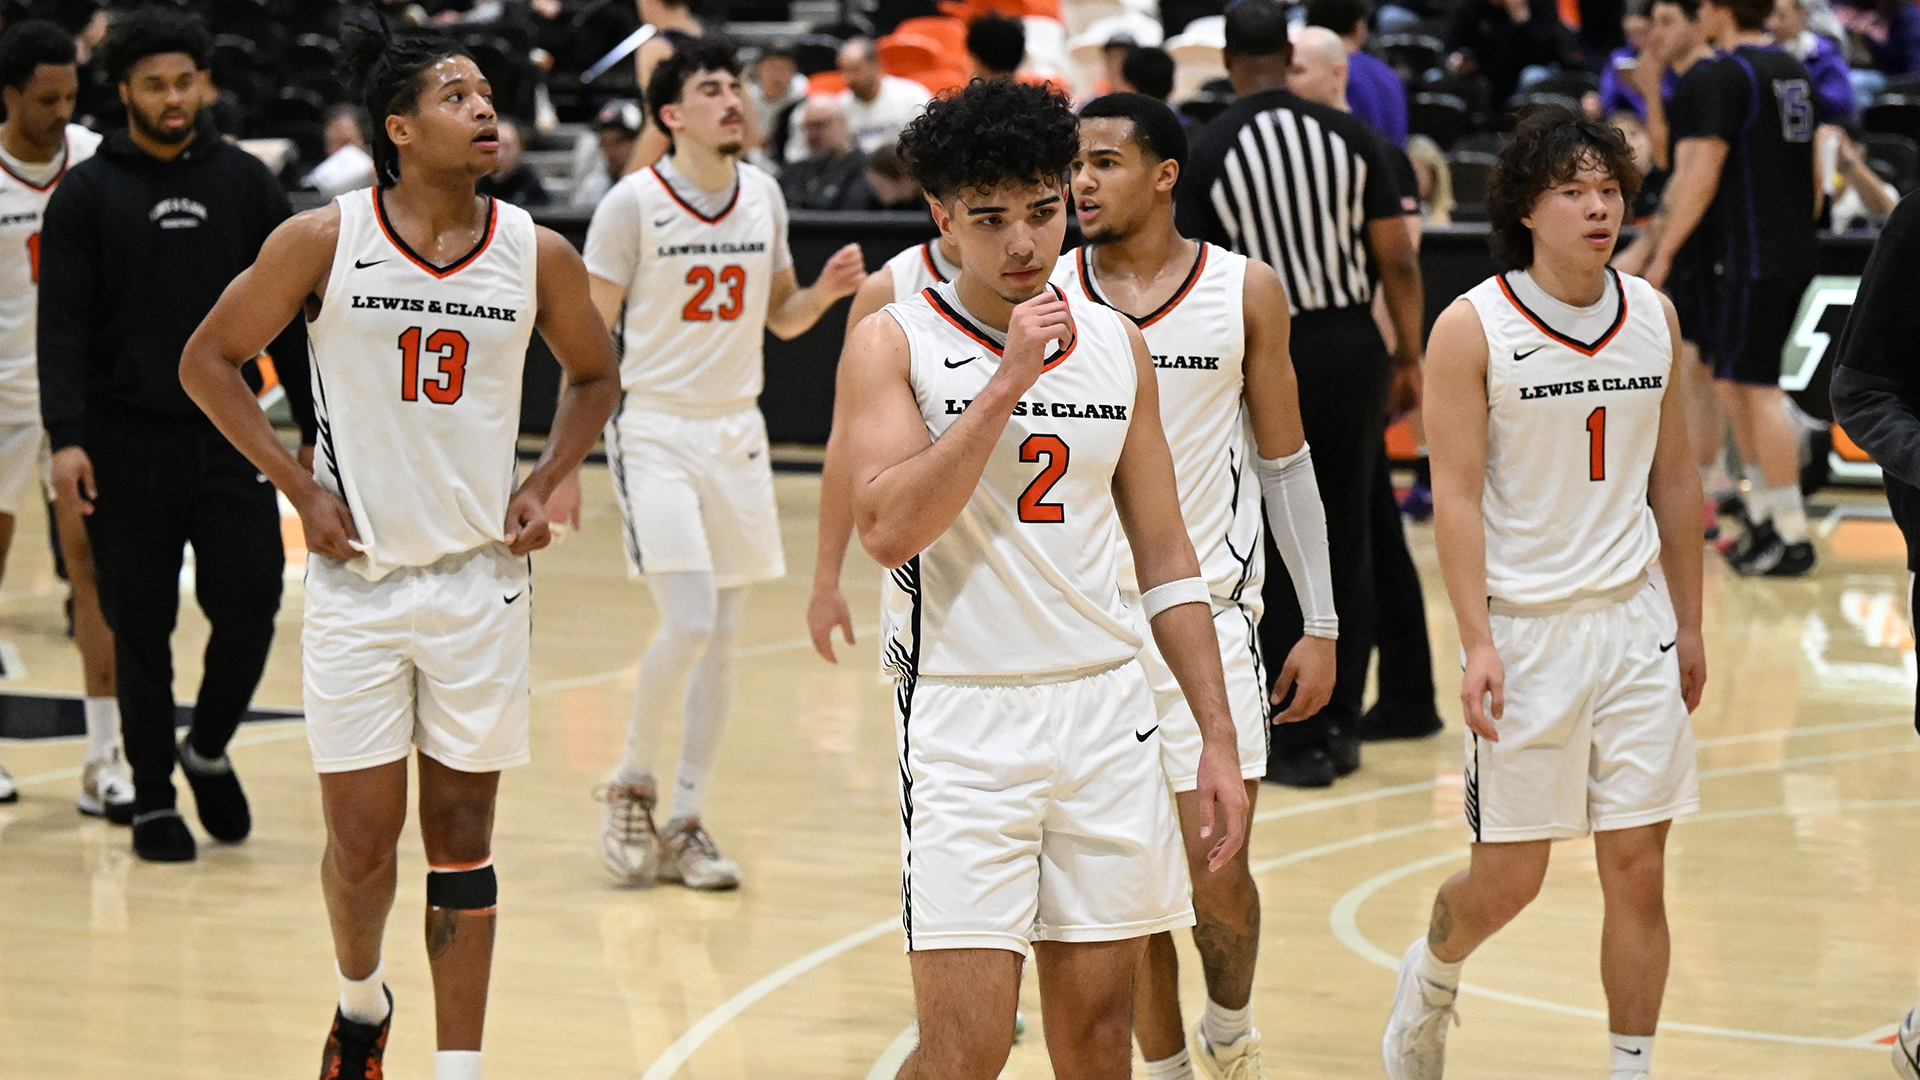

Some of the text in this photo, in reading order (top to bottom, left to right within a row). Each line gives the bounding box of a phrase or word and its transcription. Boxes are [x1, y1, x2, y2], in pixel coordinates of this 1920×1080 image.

[352, 296, 517, 322] LEWIS & CLARK
[682, 264, 746, 322] 23
[398, 325, 469, 405] 13
[1519, 376, 1662, 400] LEWIS & CLARK
[1032, 402, 1048, 417] &
[1051, 402, 1127, 420] CLARK
[1586, 406, 1606, 481] 1
[1017, 433, 1070, 524] 2
